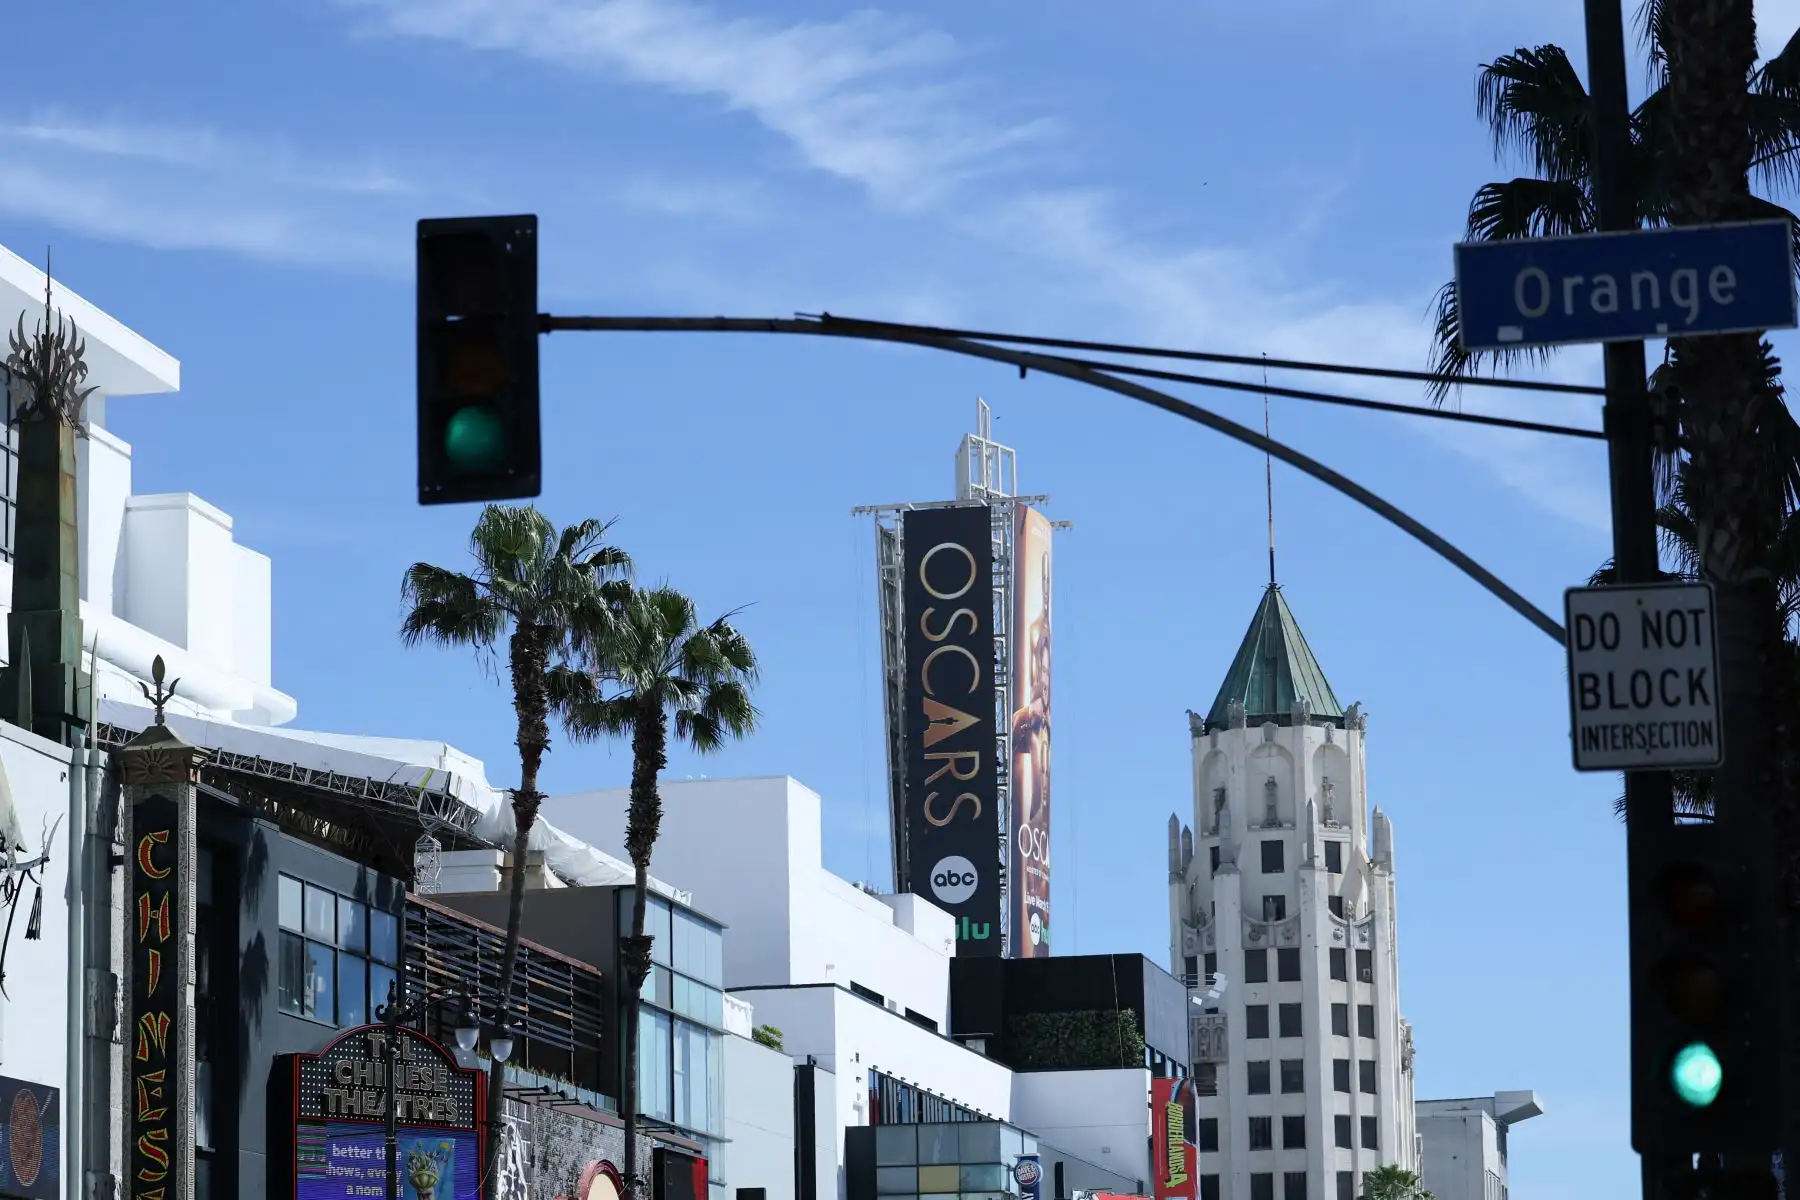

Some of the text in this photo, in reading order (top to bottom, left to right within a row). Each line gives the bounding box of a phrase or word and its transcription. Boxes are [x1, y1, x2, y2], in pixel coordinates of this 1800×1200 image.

[1514, 264, 1737, 325] Orange
[1575, 608, 1705, 652] DO NOT
[919, 542, 982, 827] OSCARS
[1578, 667, 1711, 711] BLOCK
[1581, 720, 1714, 752] INTERSECTION
[933, 869, 975, 888] abc
[955, 917, 989, 940] lu
[136, 829, 171, 1200] CHINES
[368, 1033, 416, 1060] TL
[335, 1060, 447, 1092] CHINESE
[324, 1088, 458, 1121] THEATRES
[332, 1143, 402, 1161] better thn
[1166, 1102, 1184, 1174] BORDERLANDS
